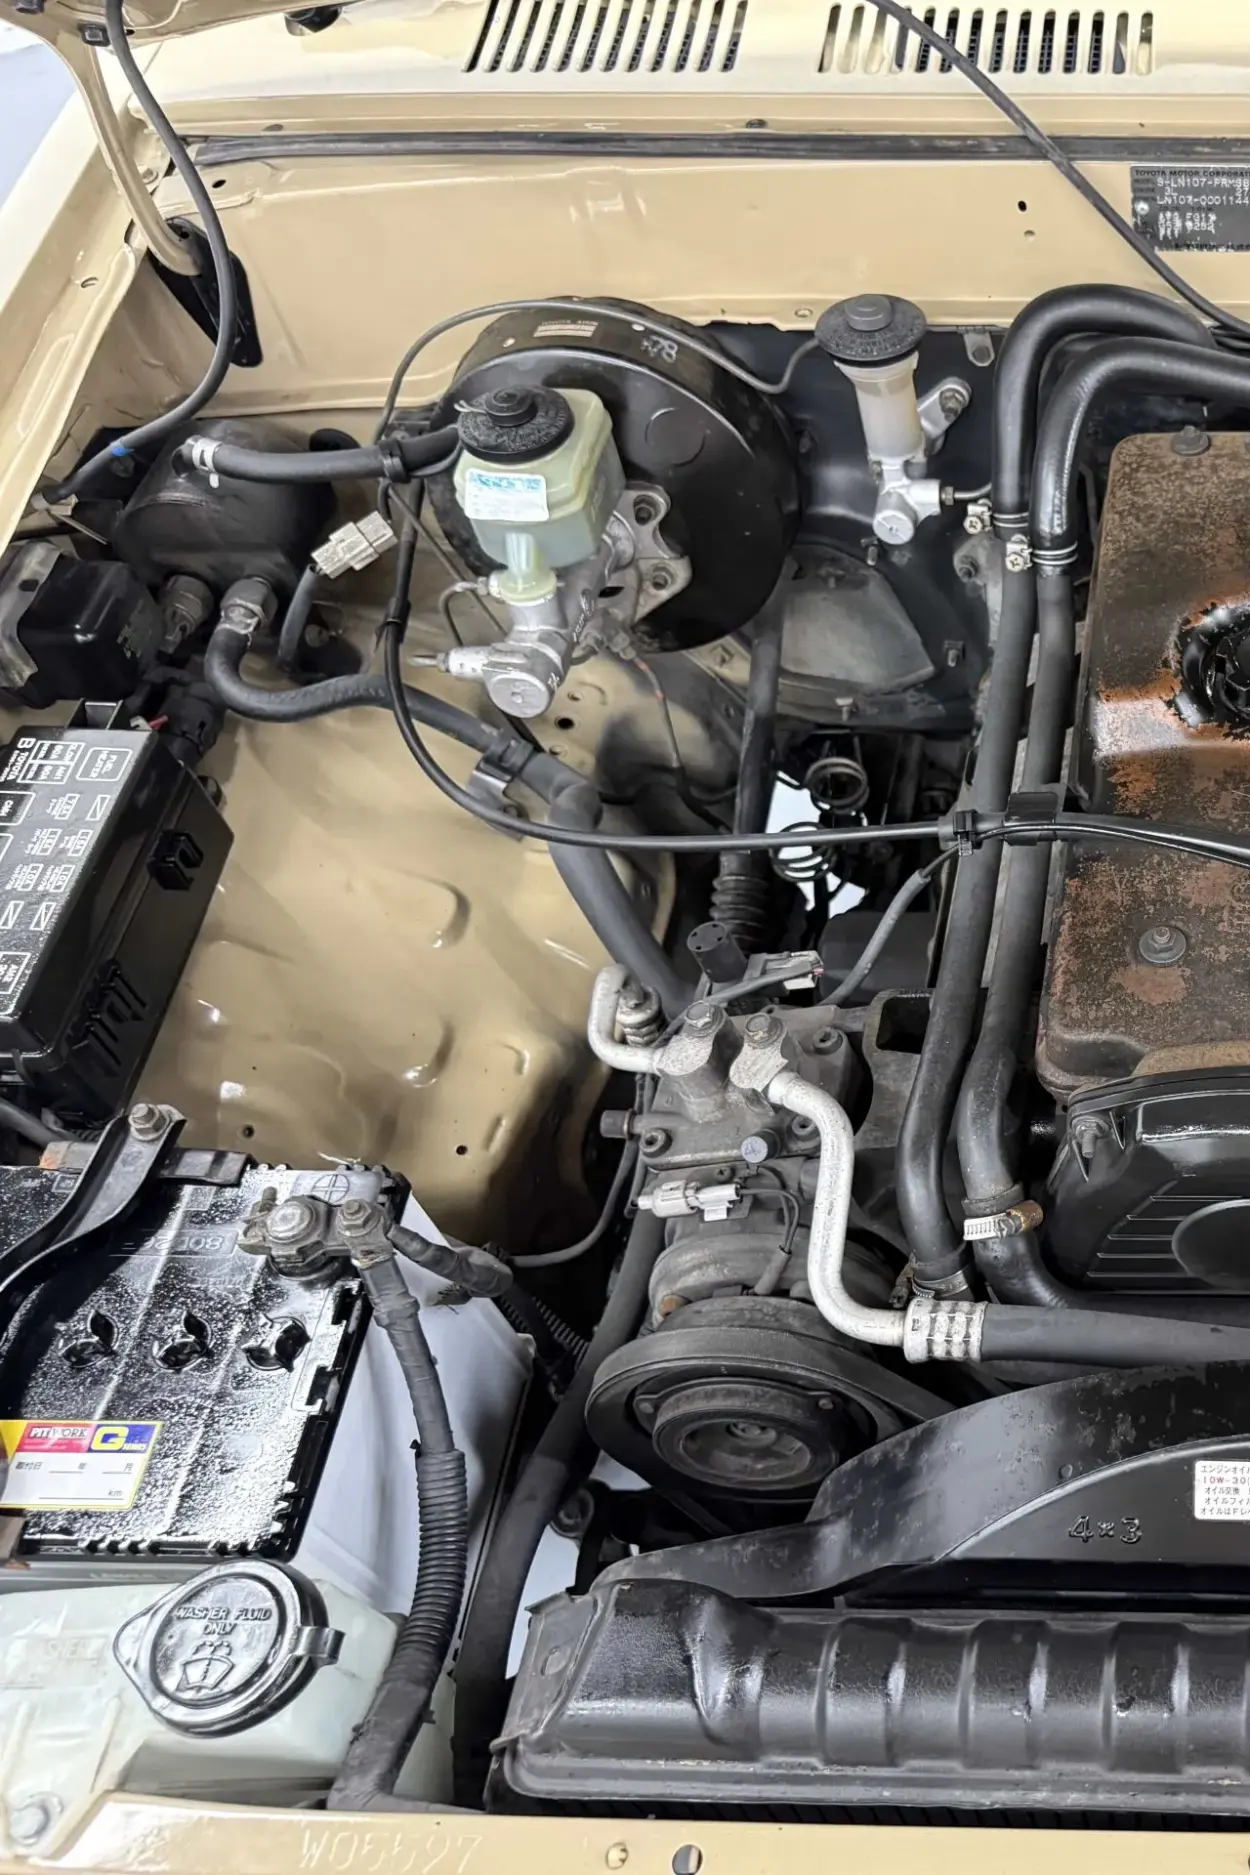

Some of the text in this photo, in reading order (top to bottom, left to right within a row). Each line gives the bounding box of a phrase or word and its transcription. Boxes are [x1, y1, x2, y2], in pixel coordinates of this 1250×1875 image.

[17, 737, 37, 749] B
[7, 751, 29, 780] TOYOTA
[89, 750, 109, 778] HEATER
[101, 754, 118, 774] FUEL
[107, 1489, 123, 1497] km
[175, 1607, 272, 1621] WASHER FLUID
[202, 1622, 238, 1635] ONLY
